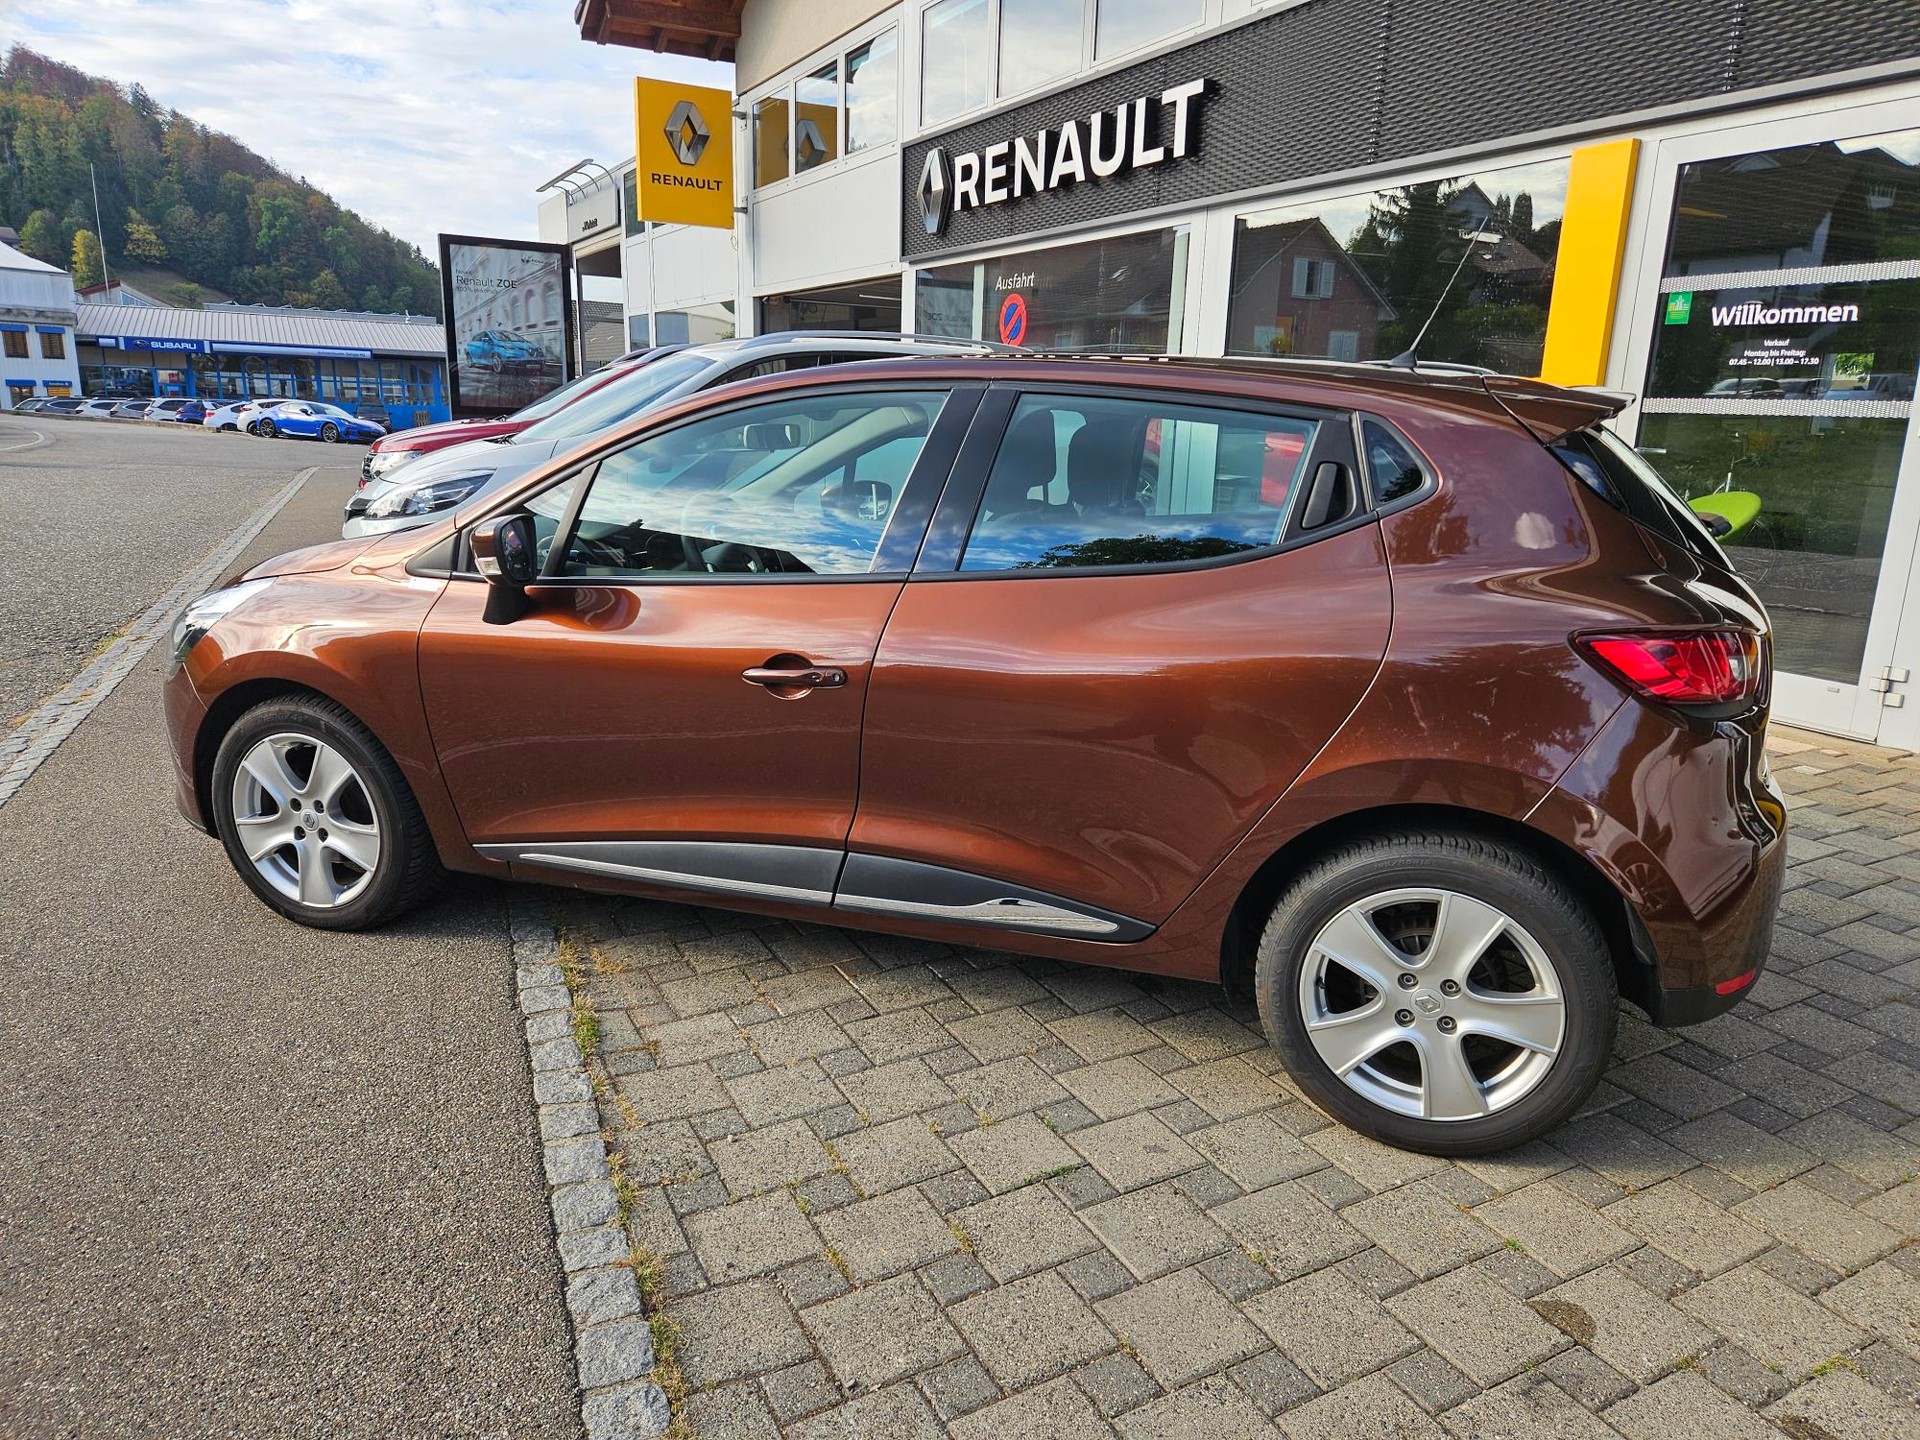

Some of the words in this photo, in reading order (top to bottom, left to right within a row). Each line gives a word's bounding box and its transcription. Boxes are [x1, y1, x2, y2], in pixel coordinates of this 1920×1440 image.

[953, 78, 1207, 212] RENAULT
[651, 173, 723, 191] RENAULT
[456, 275, 494, 287] Renault
[496, 278, 518, 289] ZOE
[994, 271, 1035, 291] Ausfahrt
[1711, 304, 1860, 327] Willkommen
[150, 341, 197, 350] SUBARU
[1763, 338, 1791, 347] Verkauf
[1743, 350, 1770, 358] Montag
[1770, 349, 1780, 357] bis
[1780, 349, 1807, 358] Freitag:
[1729, 358, 1748, 366] 07.45
[1753, 358, 1771, 366] 12.00
[1775, 357, 1794, 365] 13.00
[1800, 357, 1820, 365] 17.30
